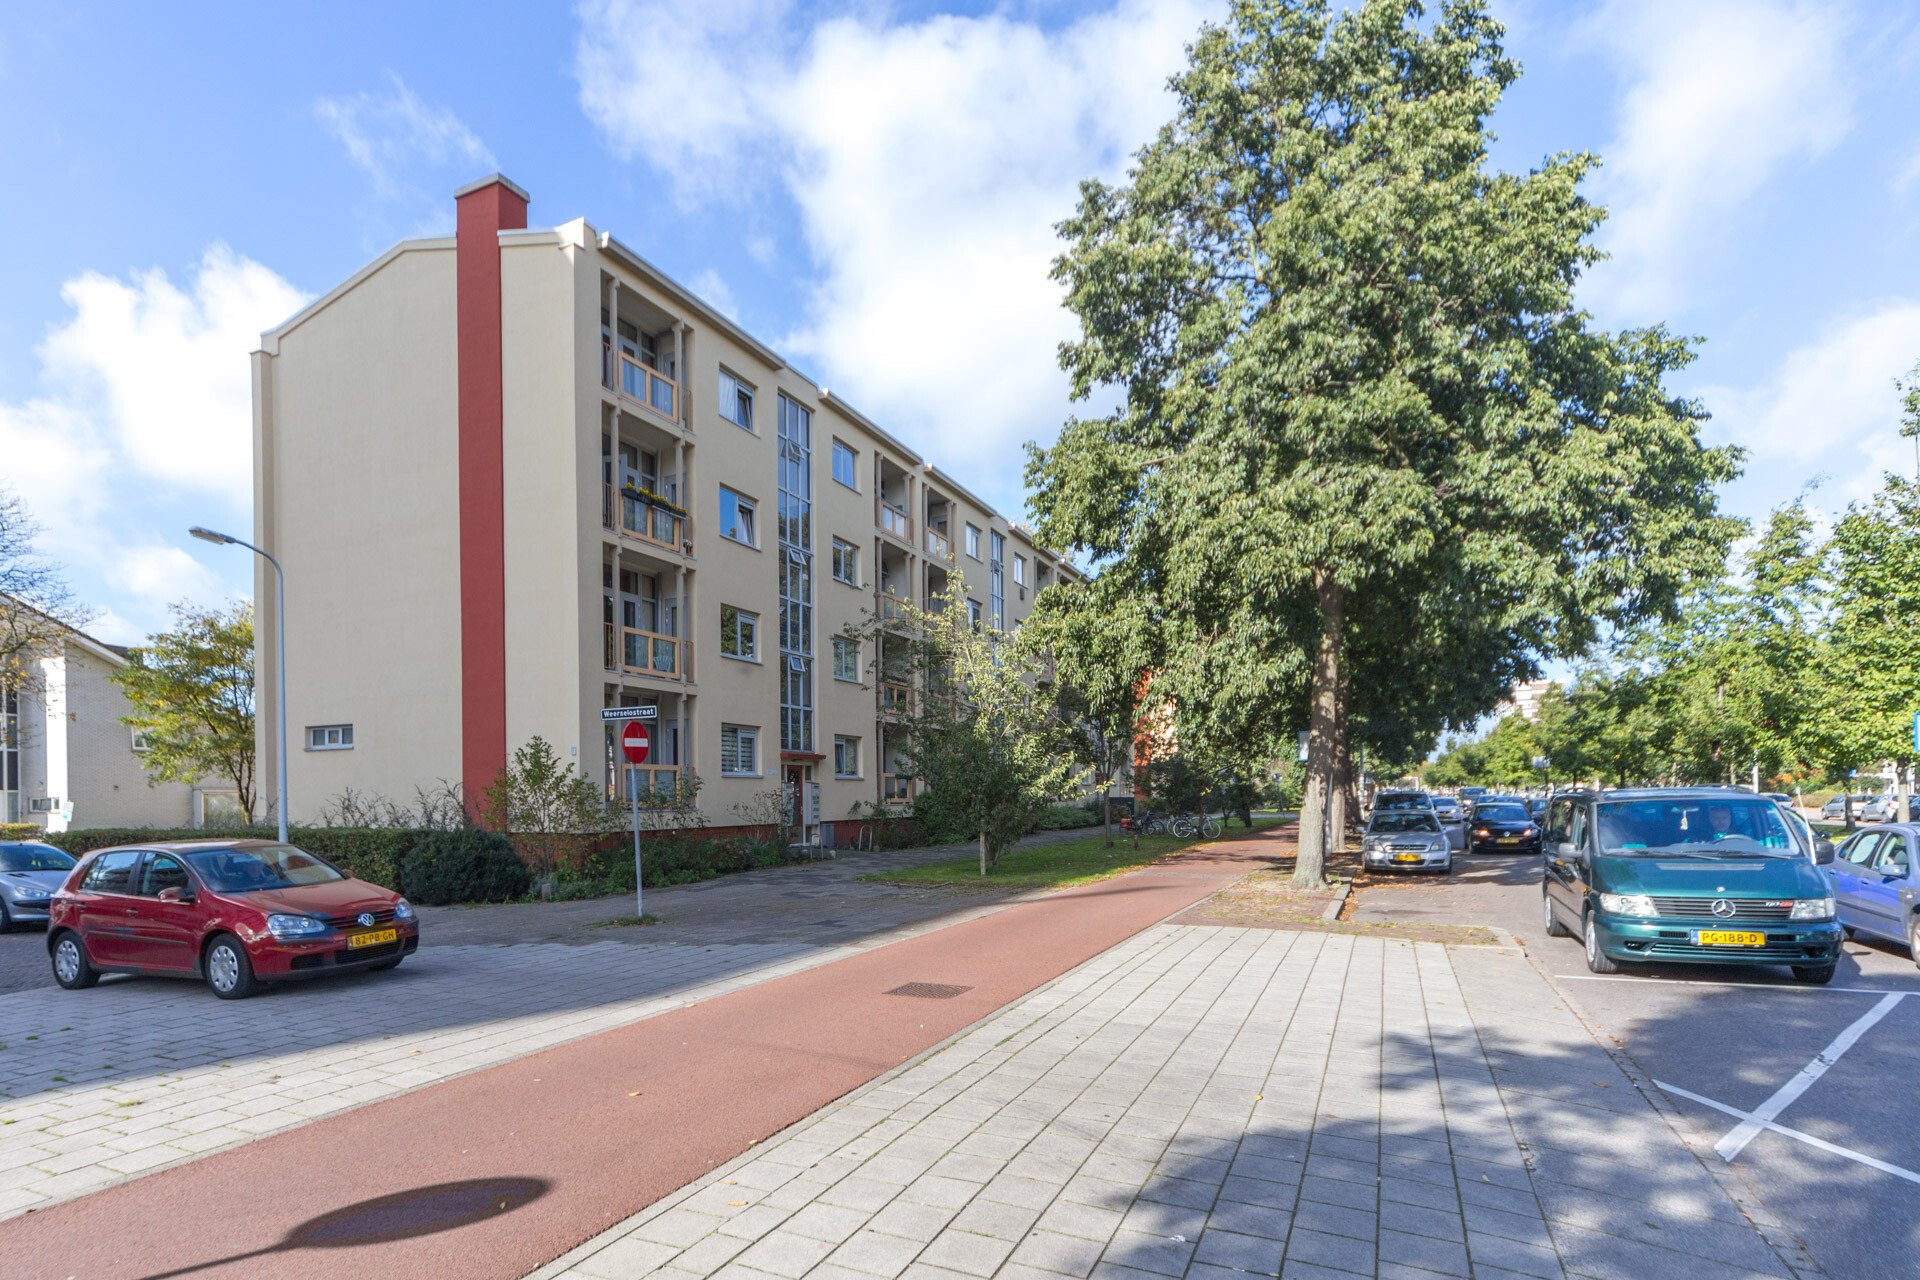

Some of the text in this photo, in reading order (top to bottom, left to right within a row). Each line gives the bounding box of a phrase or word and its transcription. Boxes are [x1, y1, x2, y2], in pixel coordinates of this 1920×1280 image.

[603, 708, 654, 718] Weerselostraat
[355, 930, 395, 946] 82-PB-GH
[1702, 932, 1758, 943] PG-188-D
